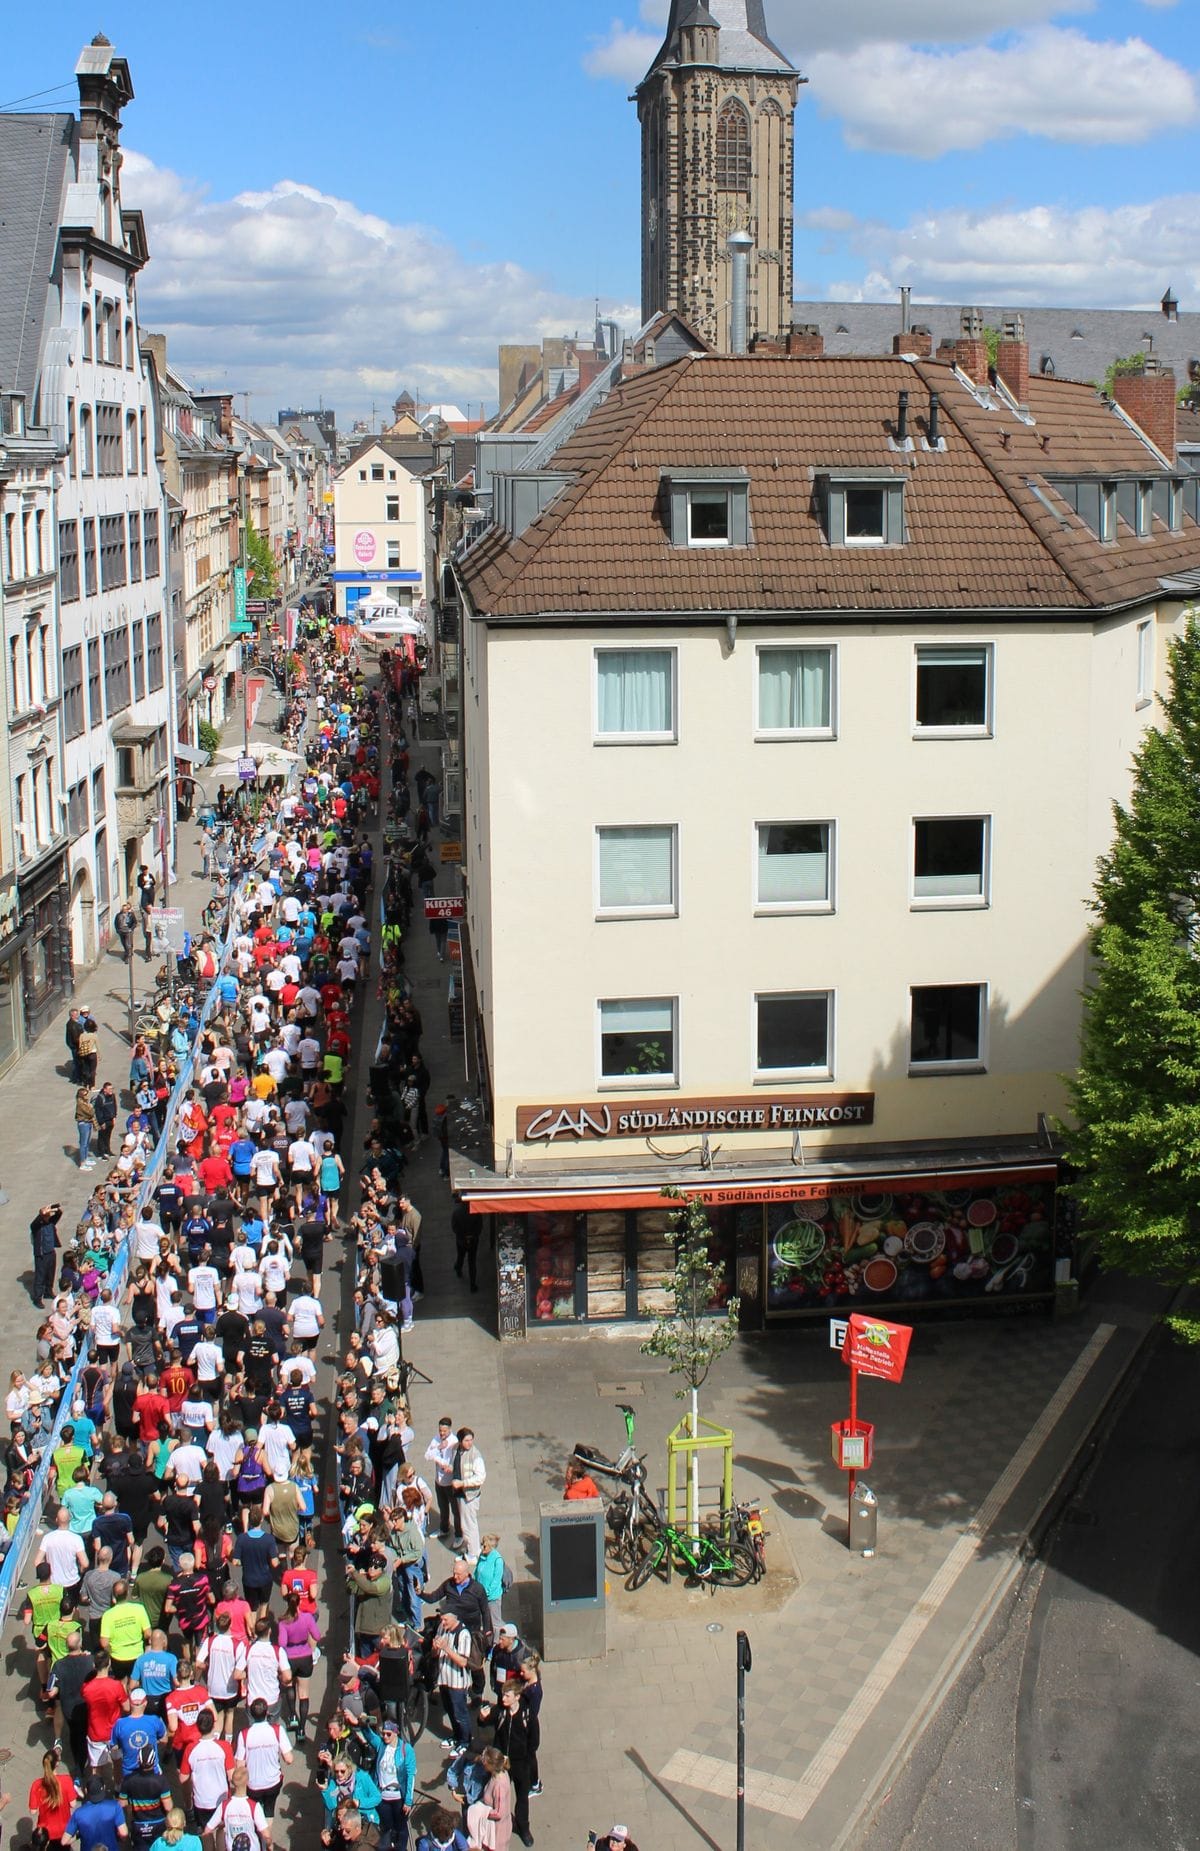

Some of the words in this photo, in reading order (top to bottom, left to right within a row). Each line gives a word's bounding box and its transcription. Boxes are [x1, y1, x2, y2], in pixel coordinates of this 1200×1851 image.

[372, 607, 401, 618] ZIEL
[425, 899, 463, 908] KIOSK
[438, 908, 452, 917] 46
[525, 1104, 613, 1140] CAN
[619, 1106, 765, 1130] SÜDLÄNDISCHE
[770, 1105, 865, 1124] FEINKOST
[687, 1192, 713, 1203] CN
[717, 1188, 806, 1201] Südländische
[810, 1183, 866, 1196] Feinkost
[170, 1377, 185, 1394] 10
[550, 1515, 594, 1524] Chlodwigplatz
